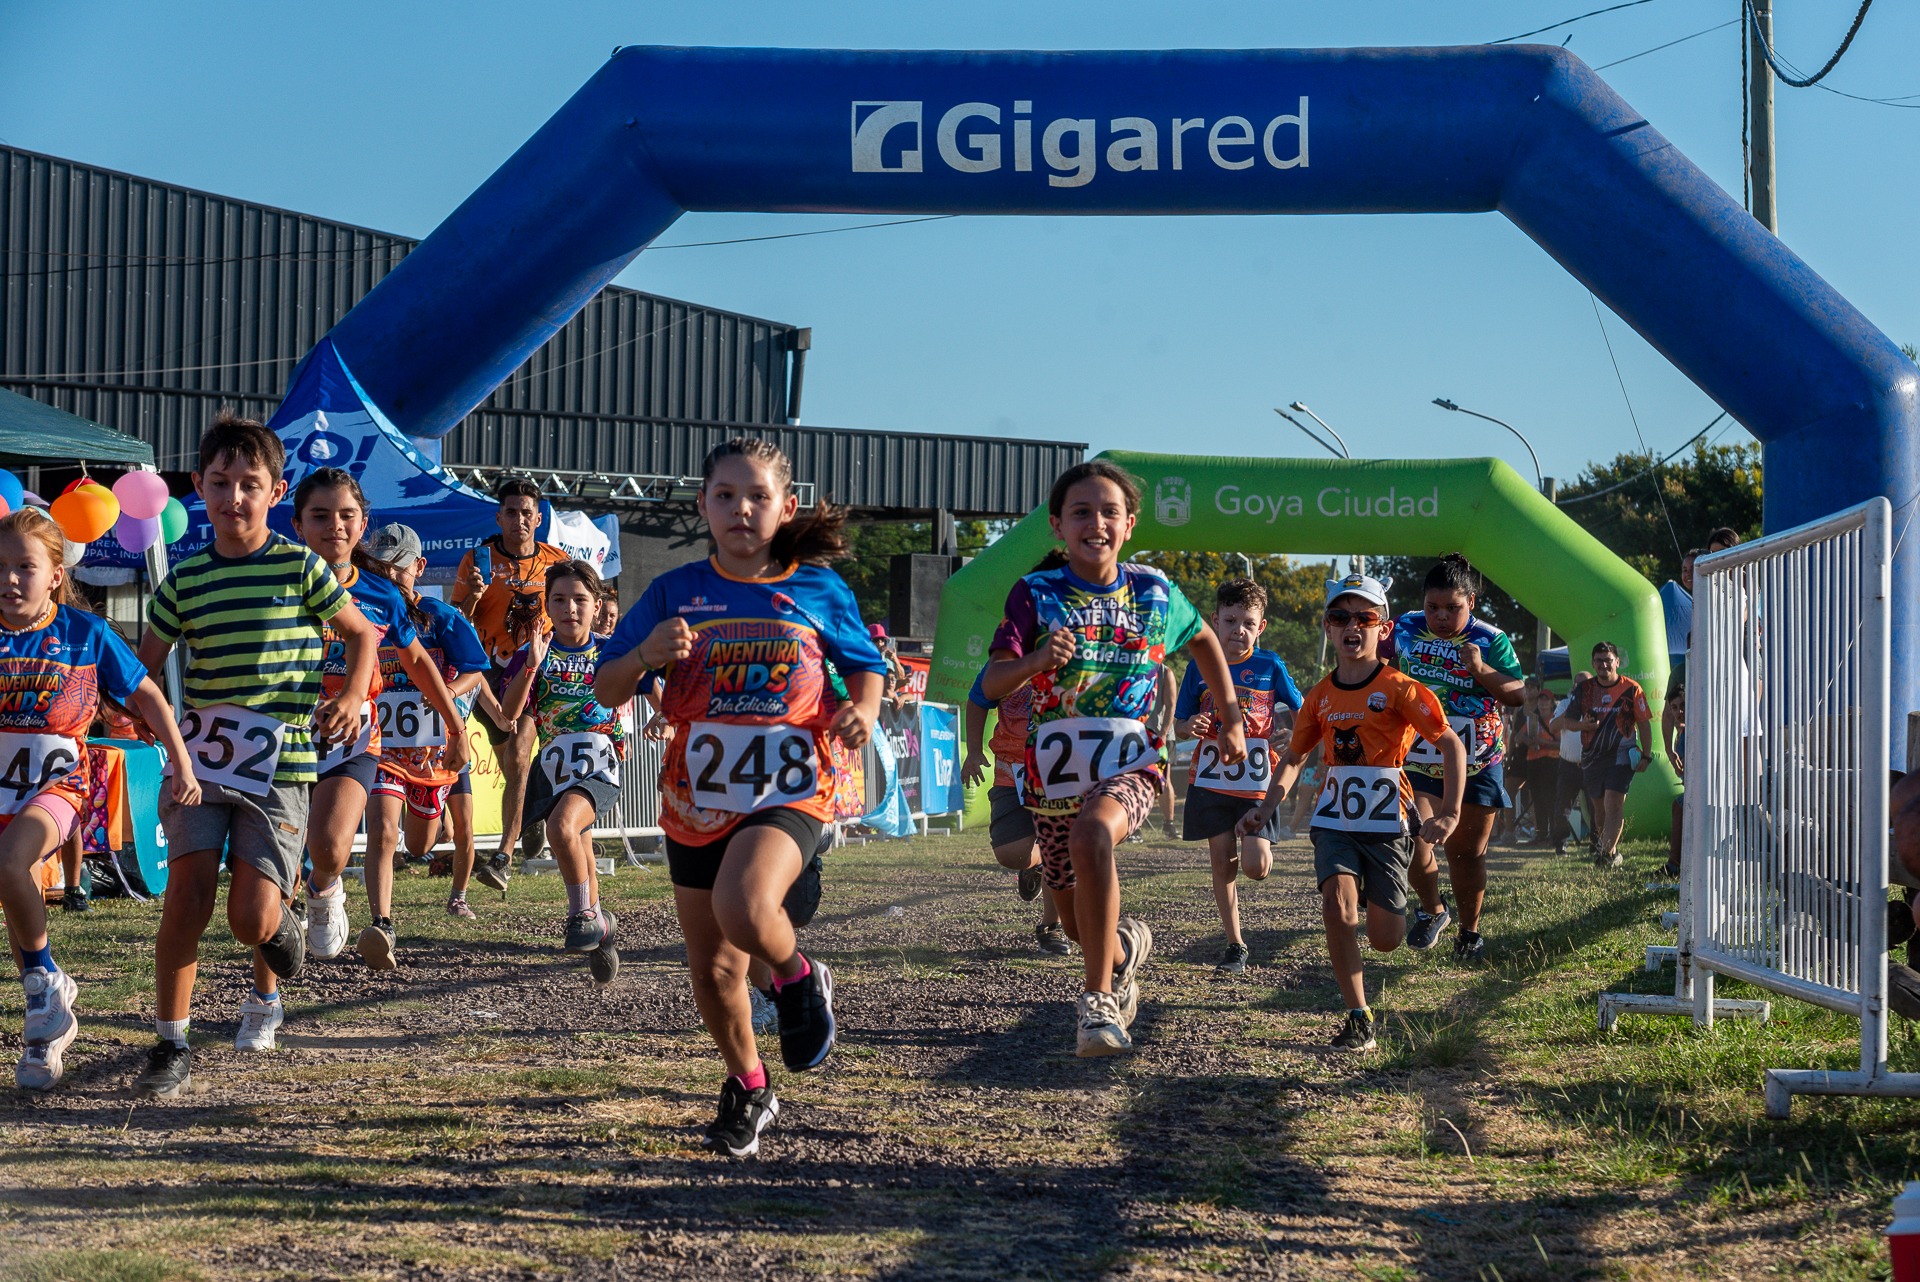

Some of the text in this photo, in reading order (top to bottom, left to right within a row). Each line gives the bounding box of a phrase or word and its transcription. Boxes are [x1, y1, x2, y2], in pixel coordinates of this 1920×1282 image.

[936, 95, 1309, 187] Gigared
[1215, 485, 1439, 524] Goya Ciudad
[1092, 598, 1118, 610] Club
[1066, 608, 1144, 632] ATENAS
[708, 639, 800, 667] AVENTURA
[1411, 641, 1461, 662] ATENA
[1432, 639, 1453, 648] Club
[567, 655, 587, 664] Club
[942, 656, 966, 670] Goya
[1073, 645, 1150, 665] Codeland
[547, 659, 595, 674] ATENA
[1410, 664, 1475, 689] Codeland
[0, 674, 59, 692] AVENTURA
[713, 663, 790, 693] KIDS
[0, 690, 53, 712] KIDS
[708, 695, 787, 715] 2da Edición
[377, 700, 441, 738] 261
[1332, 711, 1365, 721] Gigared
[690, 732, 814, 797] 248
[1316, 776, 1398, 821] 262
